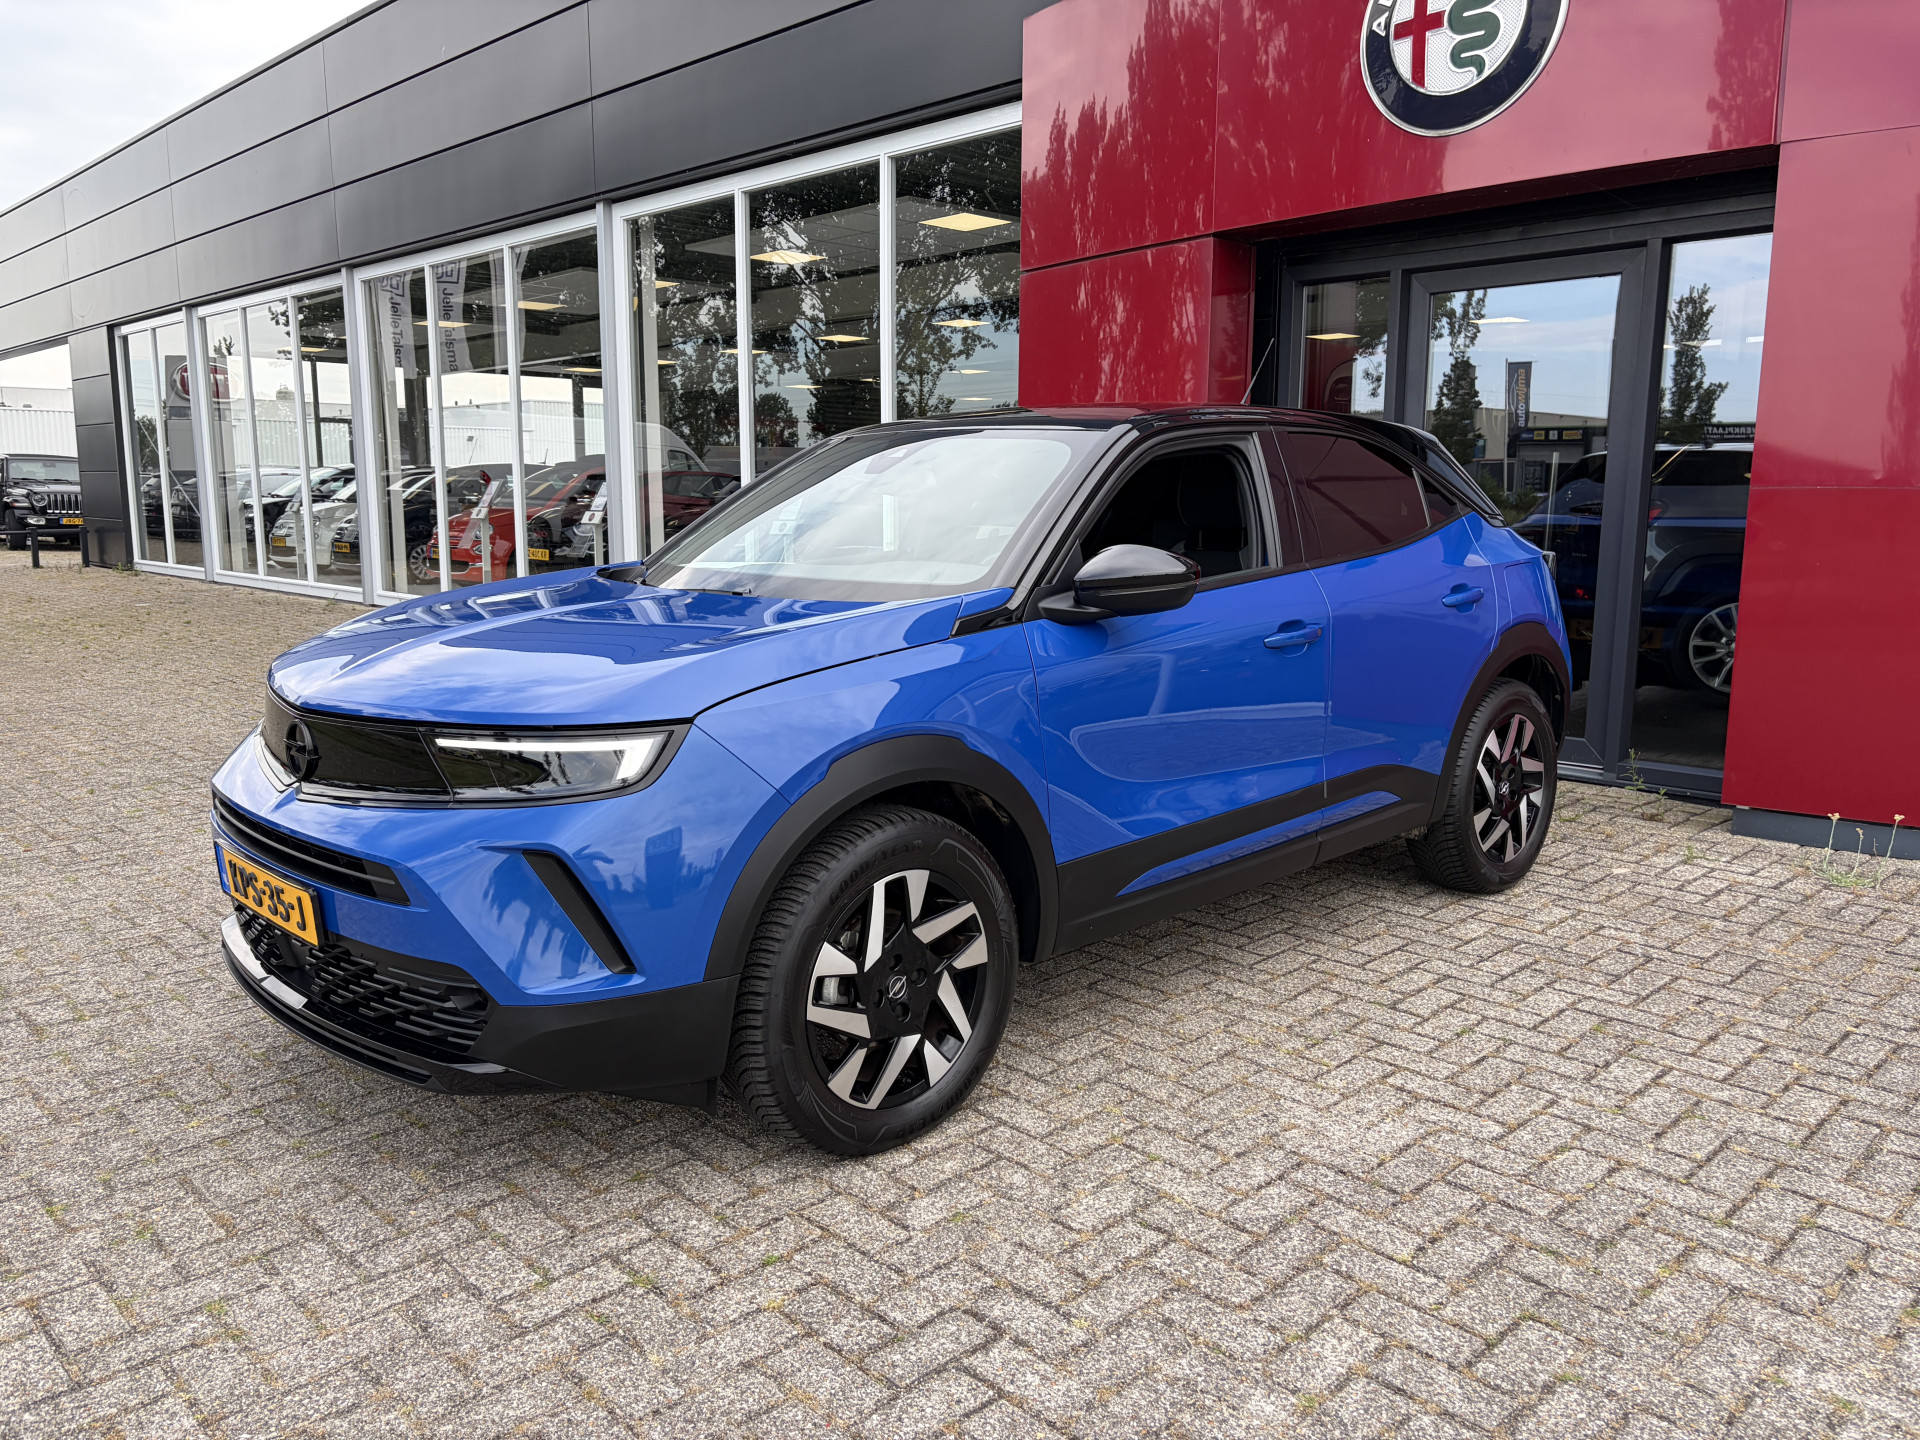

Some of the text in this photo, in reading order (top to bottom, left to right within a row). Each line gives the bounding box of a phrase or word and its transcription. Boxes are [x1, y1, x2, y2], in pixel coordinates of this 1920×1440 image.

[389, 297, 404, 367] Jelle Talsm
[442, 287, 459, 372] Jelle alsma
[228, 859, 307, 932] KPS-35-J
